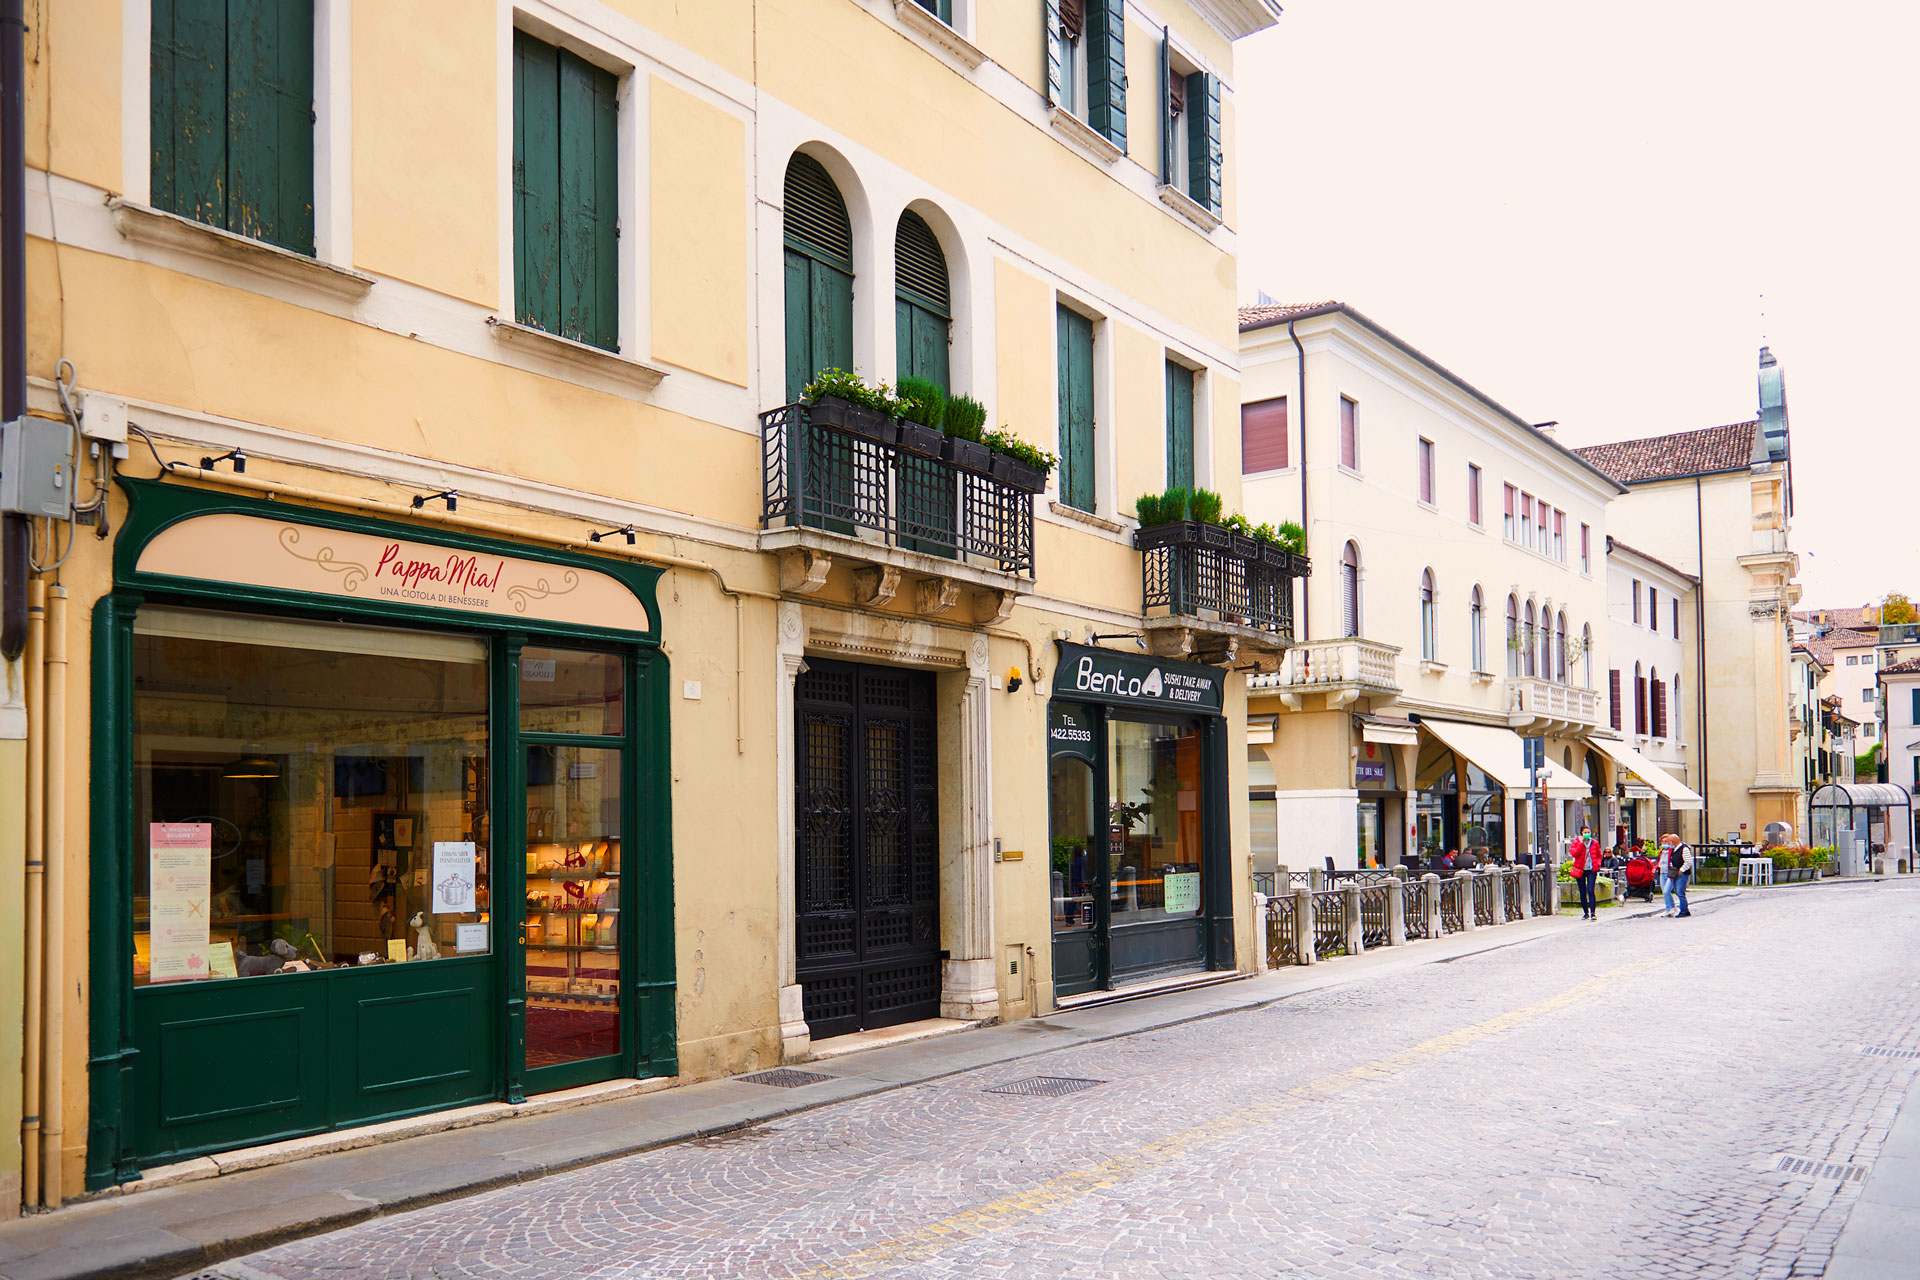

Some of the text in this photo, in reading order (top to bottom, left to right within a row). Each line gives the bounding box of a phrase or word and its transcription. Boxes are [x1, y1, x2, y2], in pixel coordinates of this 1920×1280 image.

[380, 586, 489, 608] UNA CIOTOLA DI BENESSERE
[1076, 656, 1142, 697] Bento
[1163, 672, 1213, 691] SUSHI TAKE AWAY
[1168, 687, 1202, 702] & DELIVERY
